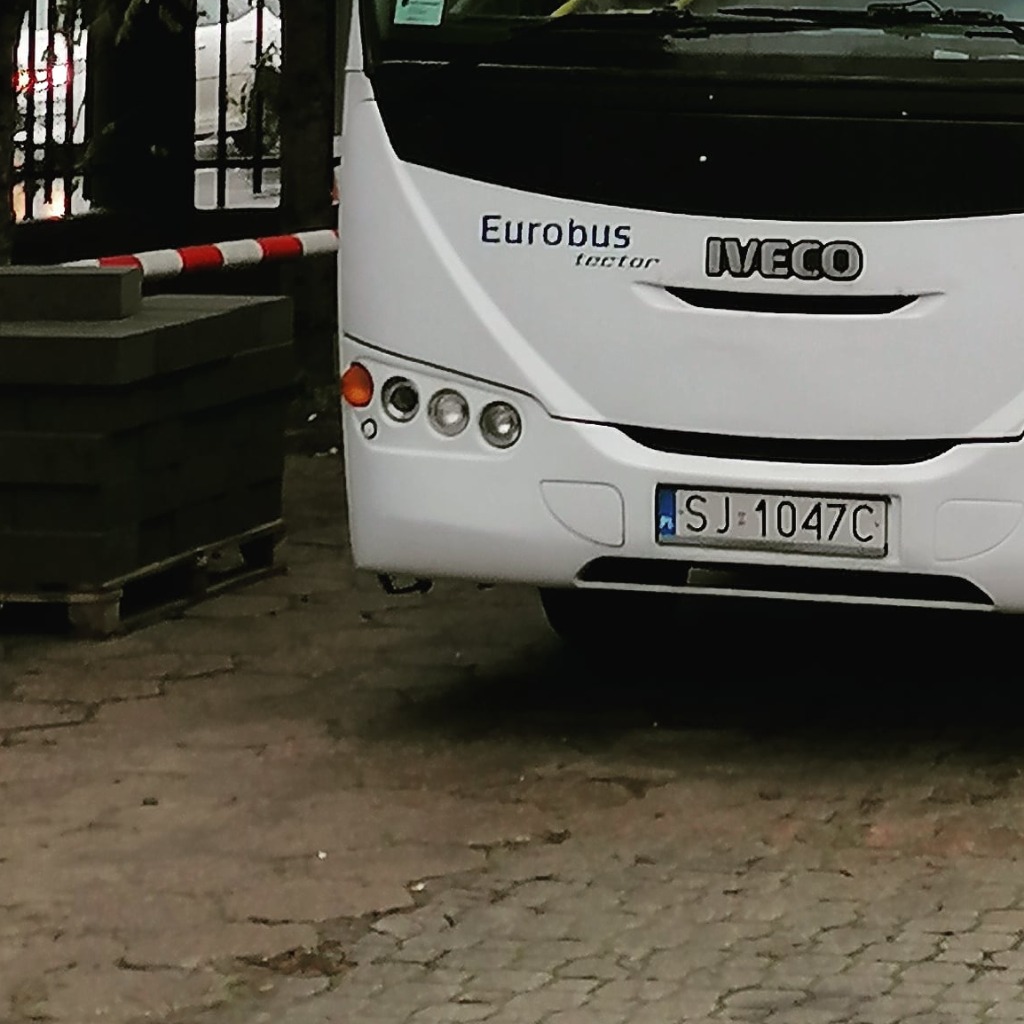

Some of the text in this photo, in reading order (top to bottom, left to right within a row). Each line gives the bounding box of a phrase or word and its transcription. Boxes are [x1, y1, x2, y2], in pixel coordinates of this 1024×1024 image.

[481, 214, 632, 249] Eurobus
[575, 252, 660, 269] tector
[705, 236, 863, 281] IVECO
[685, 494, 874, 543] SJ 1047C
